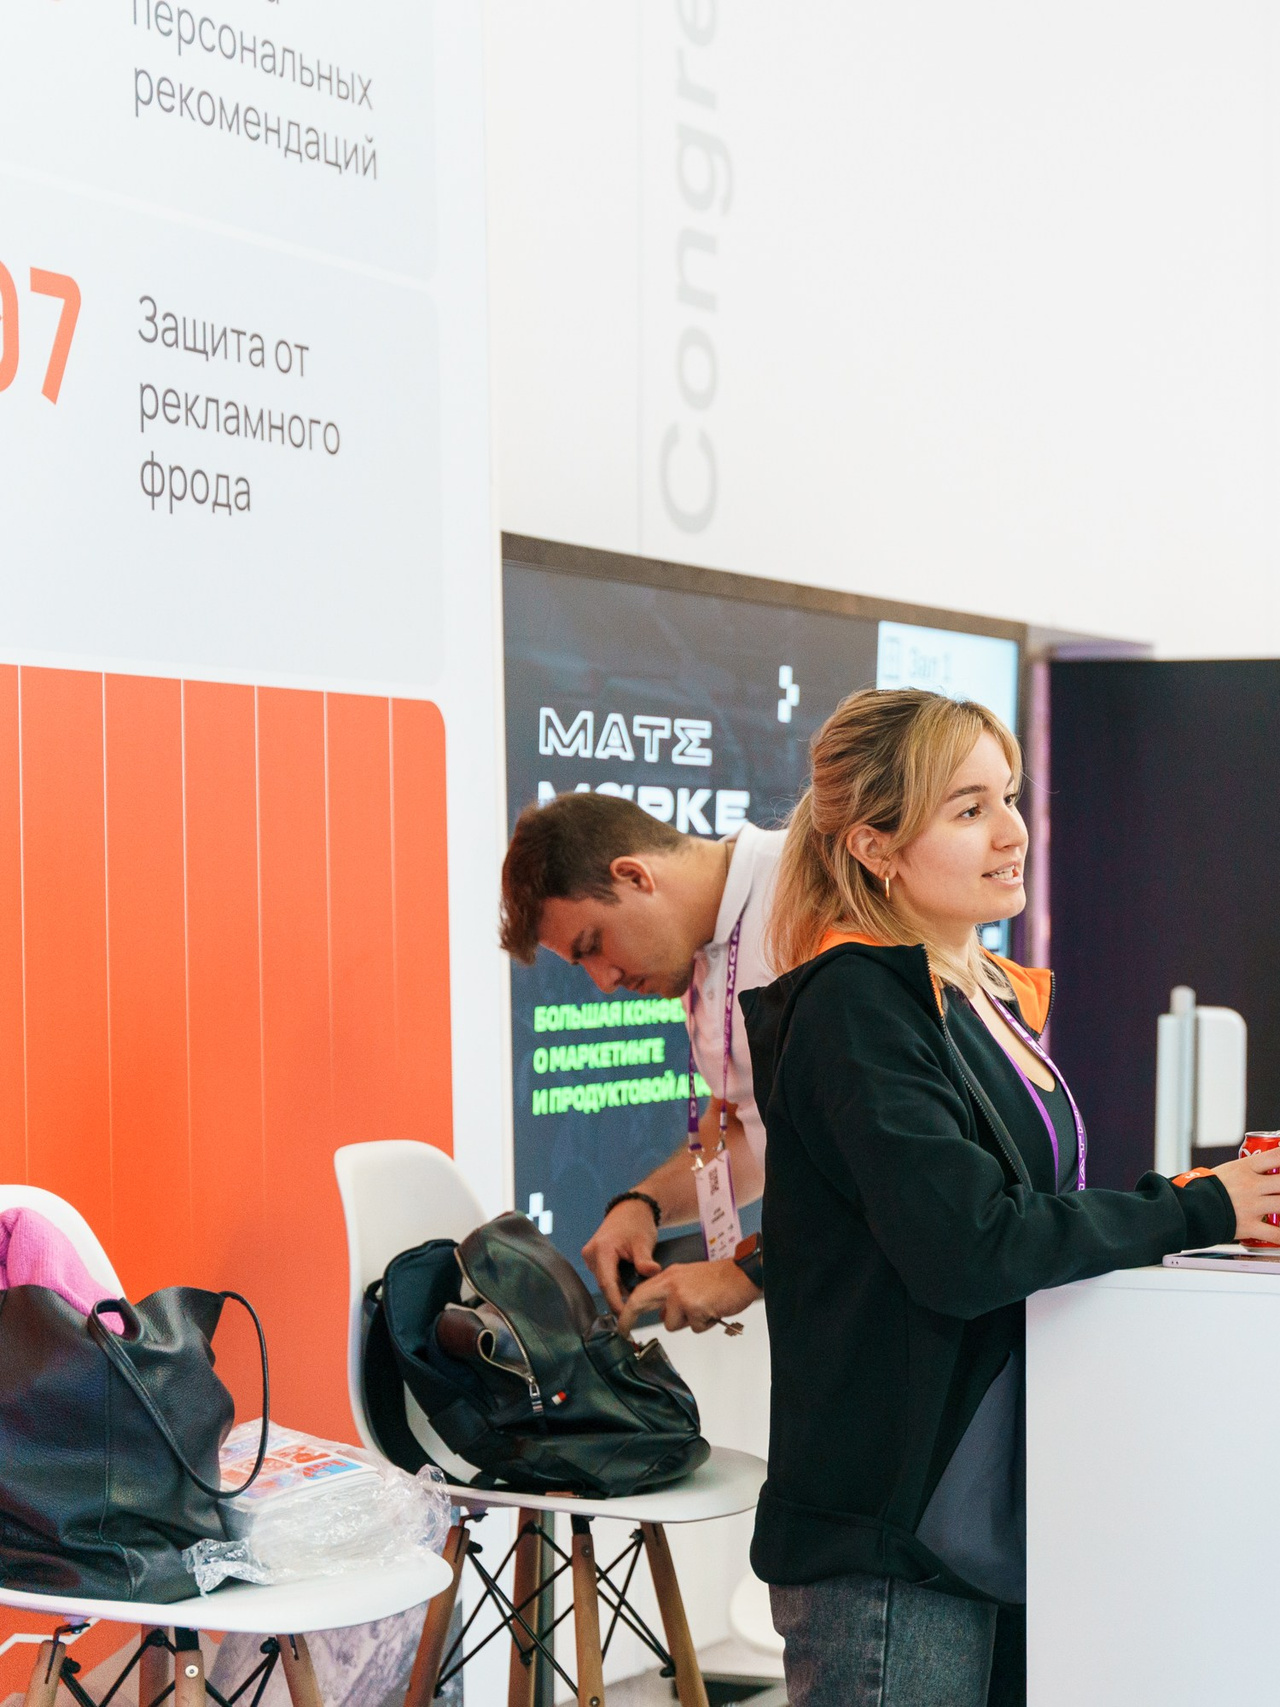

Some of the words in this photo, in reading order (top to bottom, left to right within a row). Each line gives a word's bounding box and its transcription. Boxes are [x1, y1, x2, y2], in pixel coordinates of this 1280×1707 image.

[132, 0, 374, 110] персональных
[134, 66, 378, 180] рекомендаций
[137, 295, 266, 368] Защита
[275, 339, 310, 378] от
[139, 380, 341, 457] рекламного
[139, 450, 252, 516] фрода
[533, 1001, 622, 1033] БОЛЬШАЯ
[532, 1047, 549, 1075] О
[549, 1036, 666, 1073] МАРКЕТИНГЕ
[531, 1088, 549, 1116] И
[549, 1069, 676, 1115] ПРОДУКТОВОЙ
